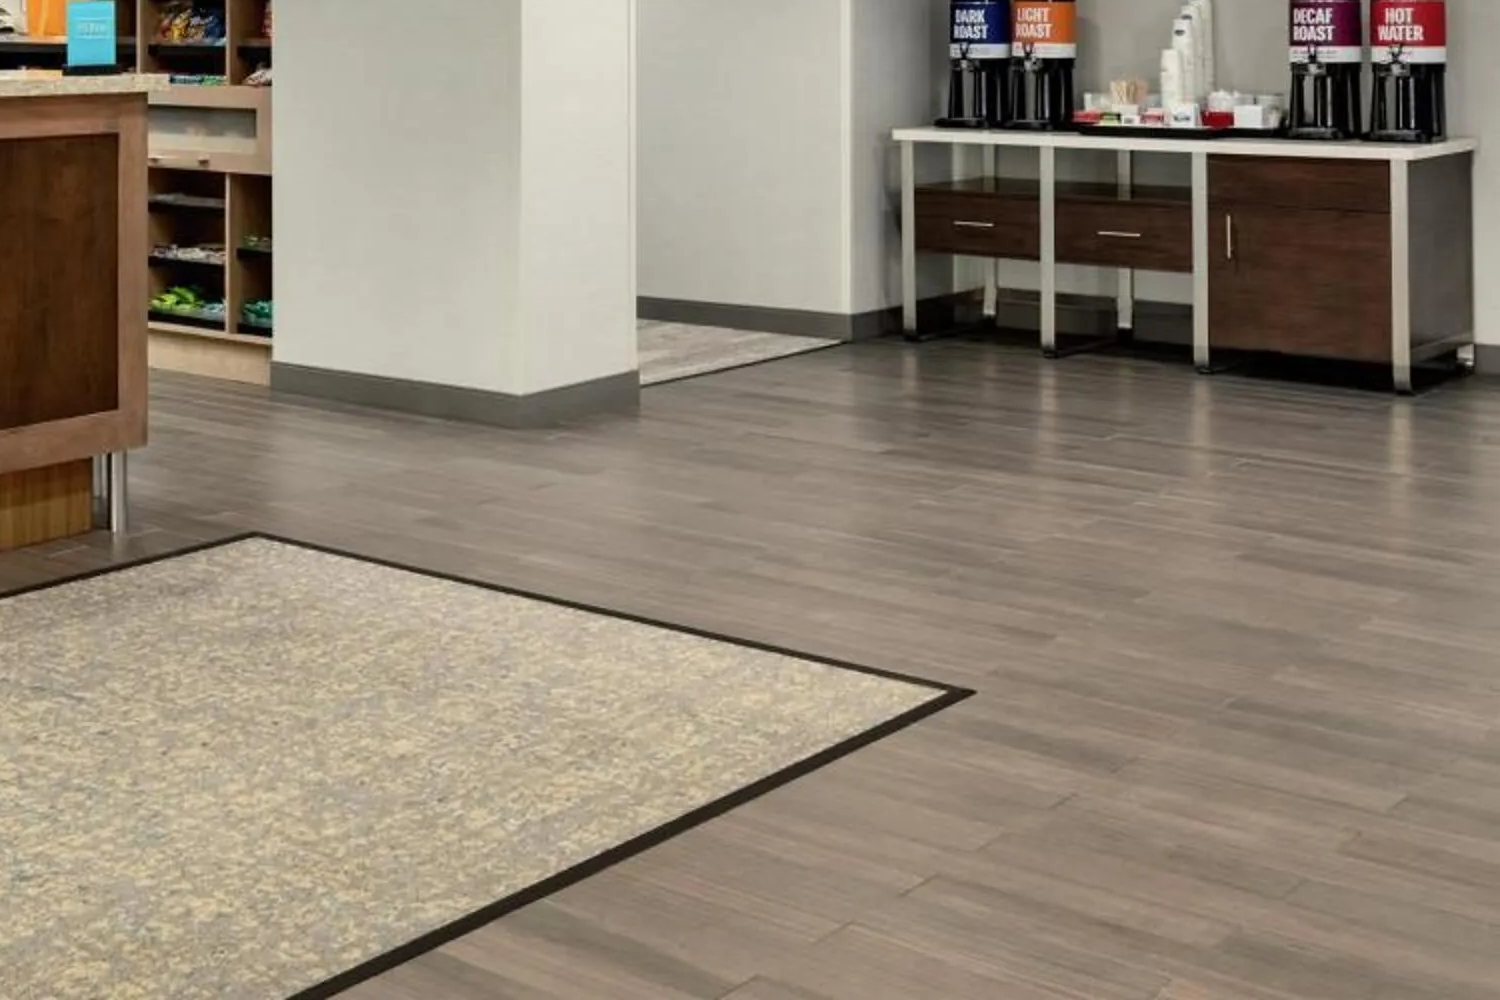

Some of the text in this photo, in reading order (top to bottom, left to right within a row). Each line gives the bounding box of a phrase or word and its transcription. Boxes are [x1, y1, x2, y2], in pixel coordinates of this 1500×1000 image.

[955, 8, 986, 23] DARK
[1016, 7, 1051, 23] LIGHT
[1293, 7, 1334, 24] DECAF
[1385, 7, 1414, 24] HOT
[953, 23, 989, 39] ROAST
[1015, 23, 1052, 39] ROAST
[1293, 25, 1336, 41] ROAST
[1377, 25, 1425, 41] WATER
